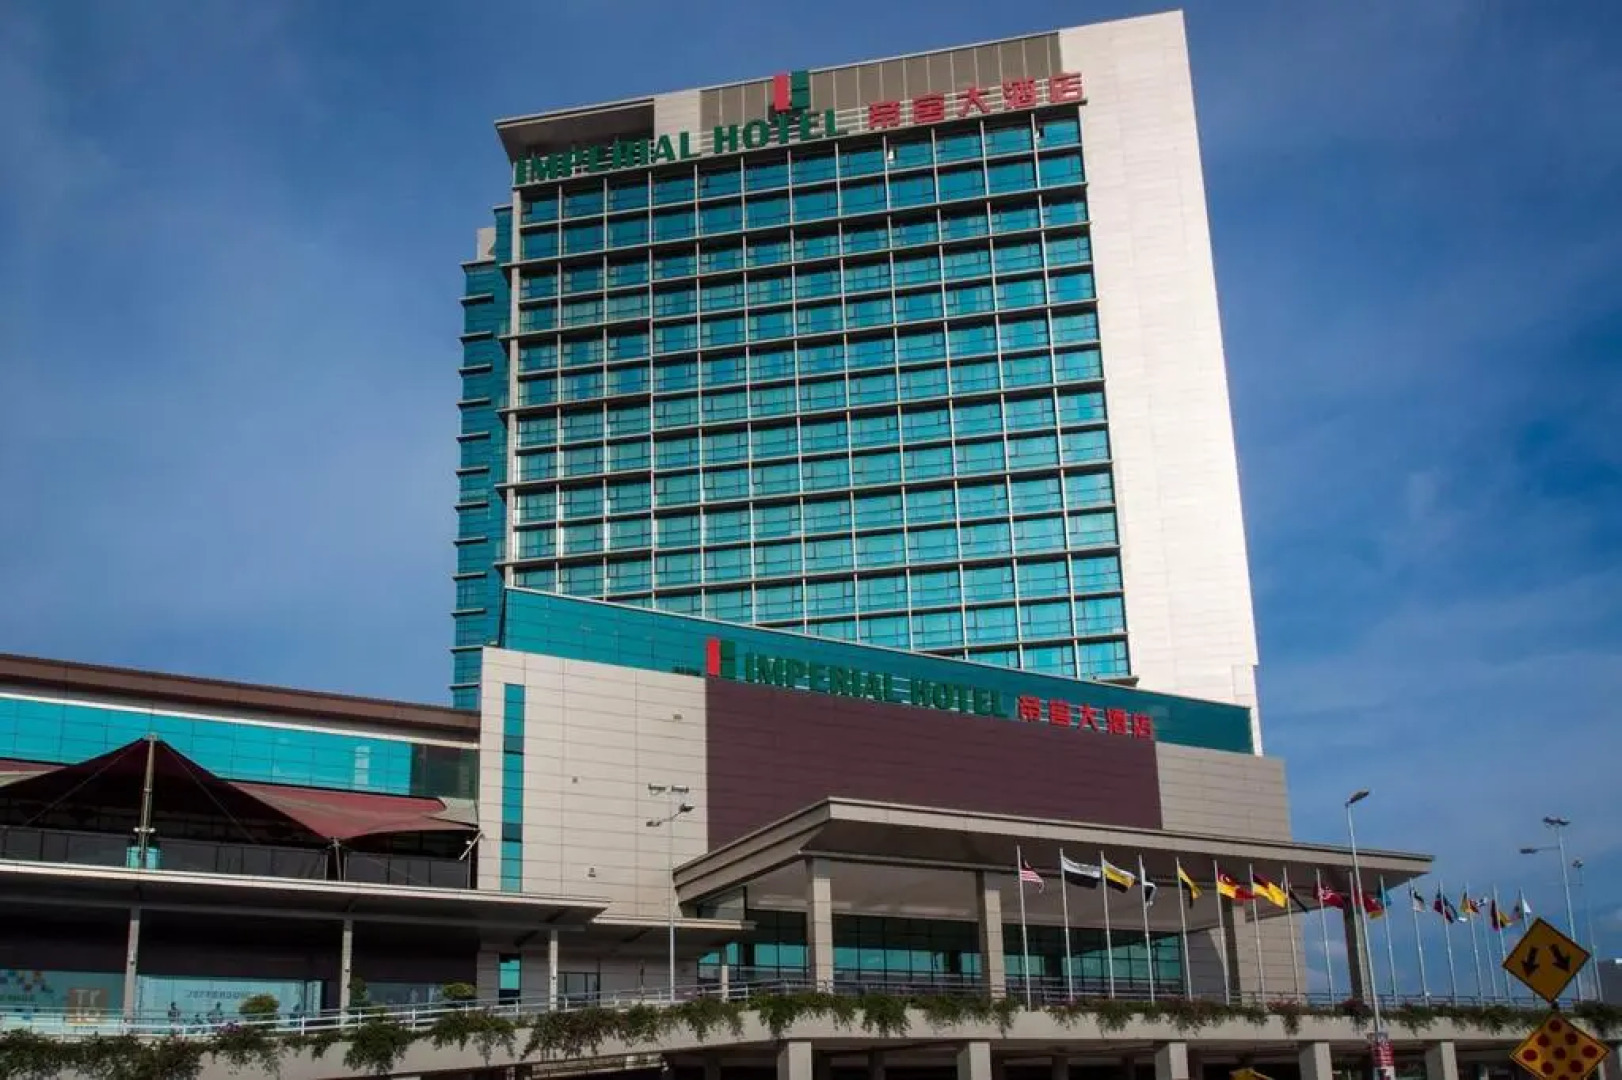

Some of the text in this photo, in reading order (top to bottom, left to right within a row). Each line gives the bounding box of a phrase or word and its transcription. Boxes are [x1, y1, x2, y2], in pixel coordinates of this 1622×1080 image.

[515, 108, 849, 185] IMPERIAL HOTEL
[746, 652, 1008, 718] IMPERIAL HOTEL
